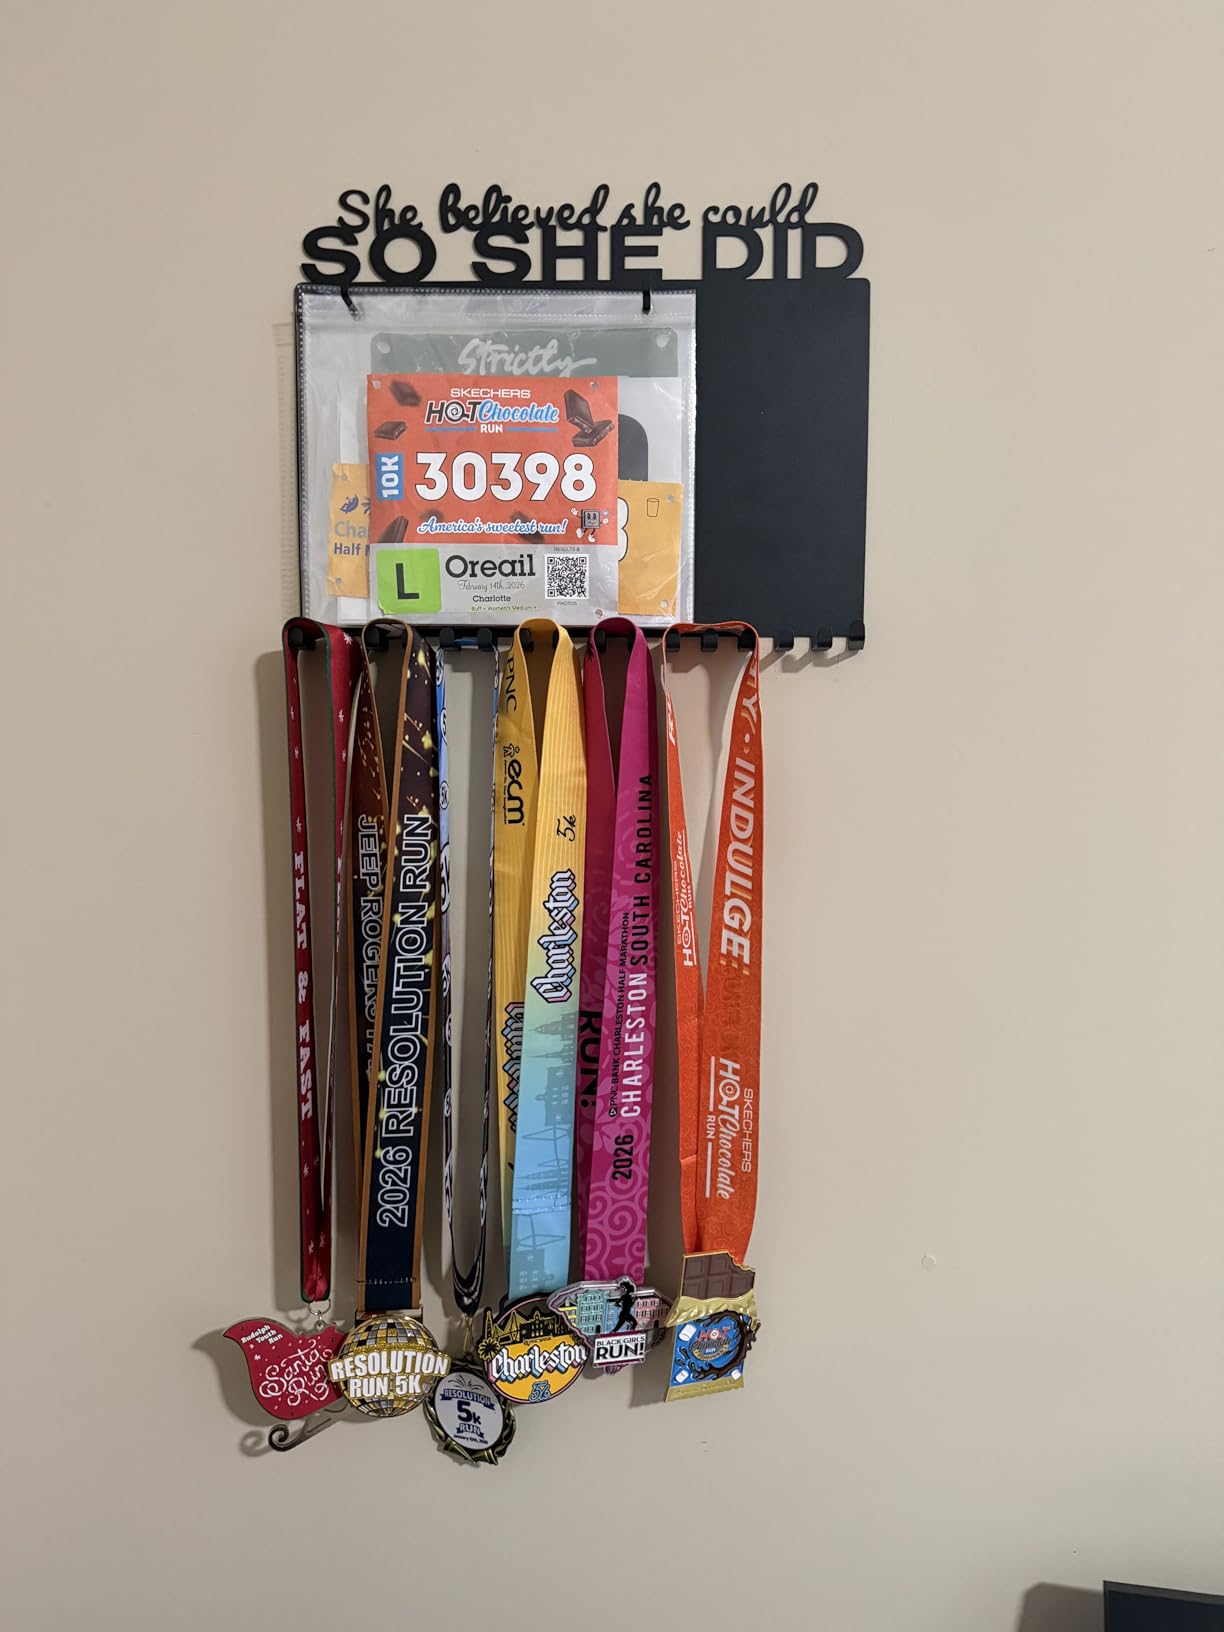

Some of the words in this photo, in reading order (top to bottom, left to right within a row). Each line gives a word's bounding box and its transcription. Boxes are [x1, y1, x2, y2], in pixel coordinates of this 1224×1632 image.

[337, 184, 423, 234] She
[439, 182, 608, 234] believed
[615, 182, 691, 230] she
[703, 182, 819, 230] could
[301, 225, 437, 283] SO
[471, 223, 663, 282] SHE
[702, 222, 864, 280] DID
[457, 338, 598, 378] Strictly
[425, 400, 482, 424] HOT
[478, 399, 560, 423] Chocolate
[450, 388, 532, 399] SKECHERS
[480, 424, 504, 434] RUN
[381, 455, 400, 498] 10K
[415, 451, 597, 502] 30398
[417, 516, 485, 534] America's
[485, 519, 537, 534] sweetest
[538, 518, 568, 534] run!
[334, 543, 361, 556] Half
[445, 554, 536, 579] Oreail
[395, 563, 420, 600] L
[457, 580, 488, 592] February
[506, 581, 525, 590] 2026
[472, 594, 511, 603] Charlotte
[505, 656, 517, 713] PNC
[507, 758, 525, 825] ecm
[634, 774, 653, 884] CAROLINA
[358, 814, 382, 891] JEEP
[399, 814, 432, 892] RUN
[676, 829, 690, 916] Chocolate
[720, 757, 756, 966] INDULGE
[294, 851, 307, 950] FLAT
[674, 861, 683, 945] SKECHERS
[530, 868, 579, 1003] Charleston
[619, 912, 630, 966] MARATHON
[629, 896, 651, 966] SOUTH
[680, 912, 694, 967] HOT
[298, 971, 310, 1004] &
[618, 968, 627, 993] HALF
[381, 902, 428, 1138] RESOLUTION
[613, 995, 625, 1056] CHARLESTON
[621, 973, 648, 1118] CHARLESTON
[299, 1019, 313, 1120] FAST
[611, 1057, 620, 1084] BANK
[718, 1057, 741, 1118] HOT
[706, 1114, 716, 1139] RUN
[741, 1088, 754, 1173] SKECHERS
[612, 1134, 635, 1181] 2026
[717, 1115, 740, 1200] Chocolate
[376, 1145, 412, 1228] 2026
[241, 1325, 271, 1344] Rudolph
[256, 1329, 277, 1343] Youth
[268, 1333, 284, 1344] Run
[595, 1342, 645, 1360] RUN!
[596, 1338, 622, 1347] BLACK
[623, 1335, 645, 1344] GIRLS
[259, 1339, 333, 1398] Santa
[331, 1350, 450, 1381] RESOLUTION
[491, 1342, 587, 1382] Charleston
[288, 1364, 329, 1406] Run
[349, 1376, 388, 1398] RUN
[395, 1375, 422, 1395] 5K
[444, 1389, 491, 1406] RESOLUTION
[459, 1423, 481, 1437] RUN
